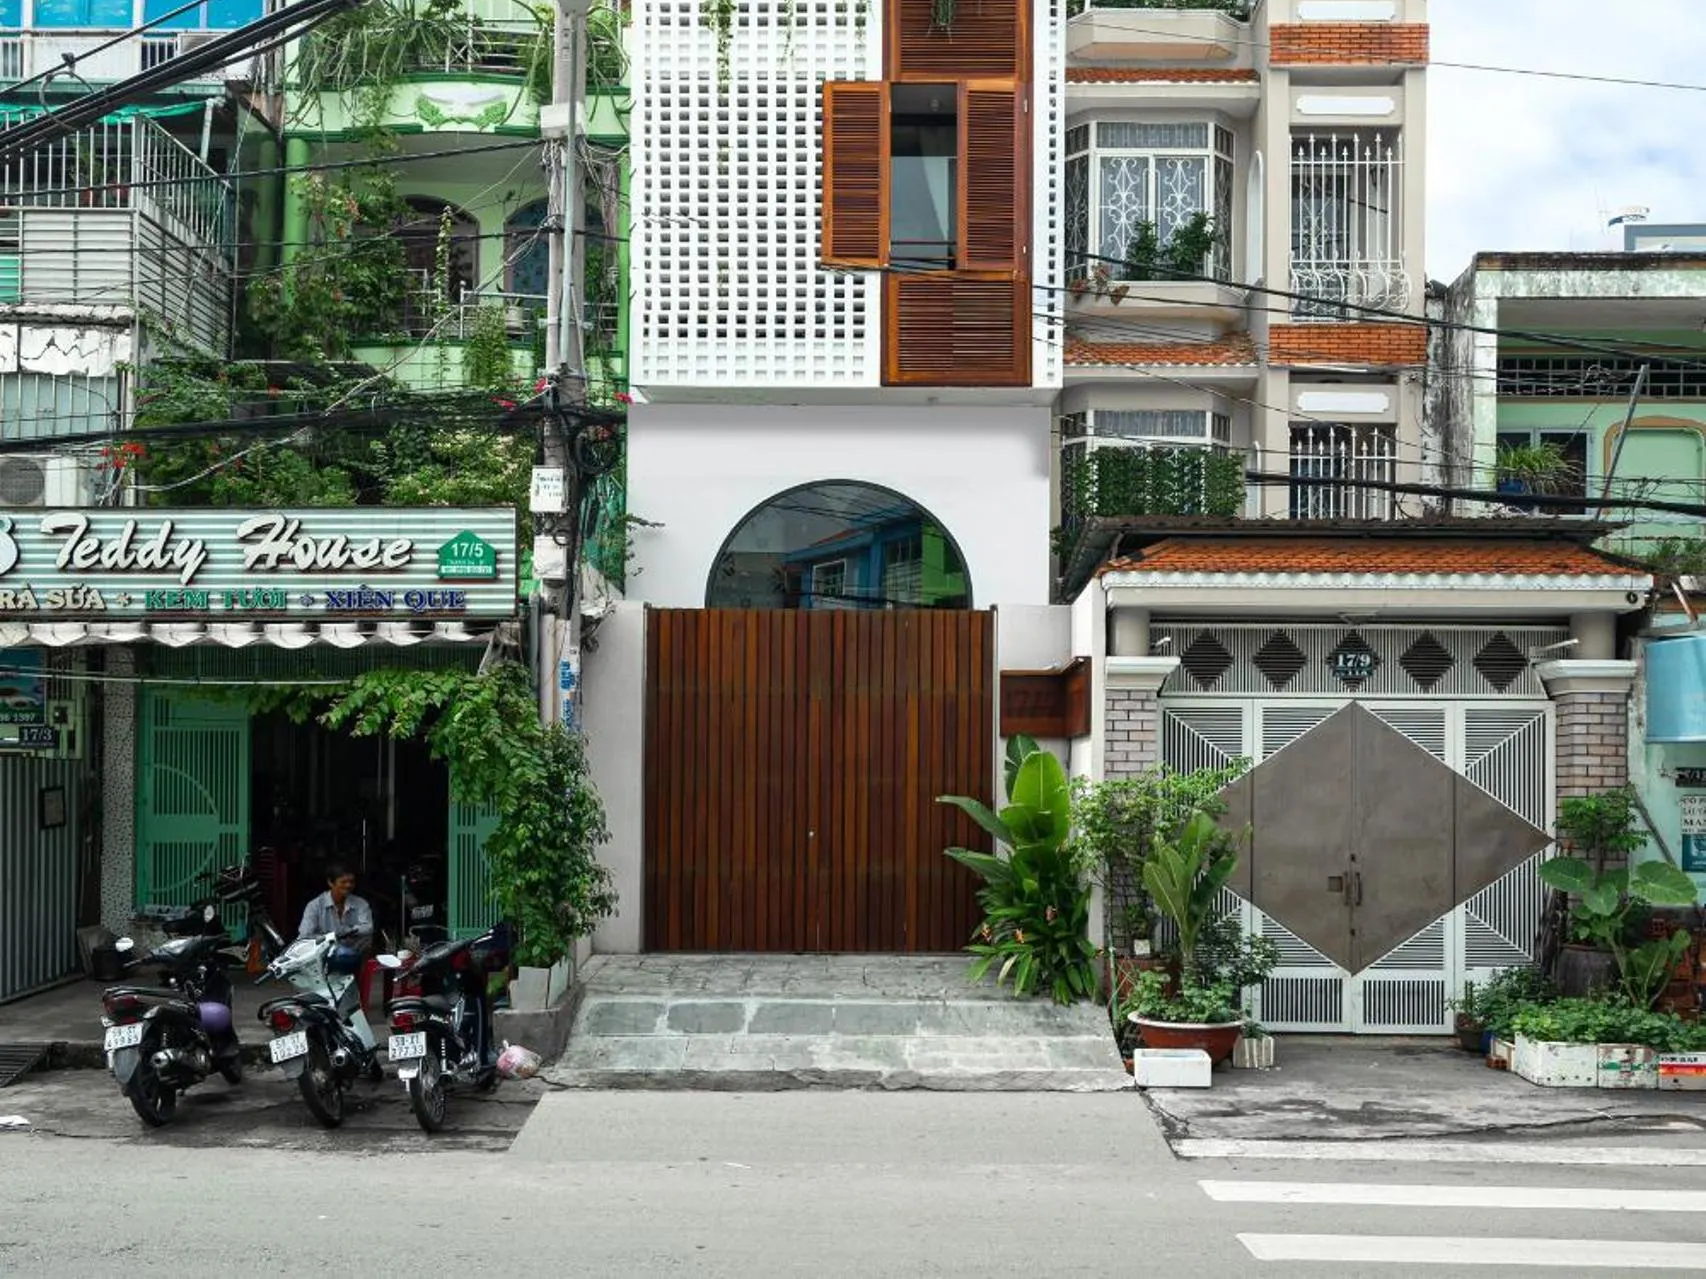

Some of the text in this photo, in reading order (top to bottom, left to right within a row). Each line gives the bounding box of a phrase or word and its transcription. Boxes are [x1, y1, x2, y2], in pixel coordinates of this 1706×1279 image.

[40, 512, 413, 586] Teddy House
[451, 542, 484, 558] 17/5
[145, 590, 209, 609] KEM
[325, 584, 394, 609] XIÊN
[404, 589, 466, 613] QUE
[1338, 654, 1371, 667] 17/9
[23, 728, 52, 741] 17/3
